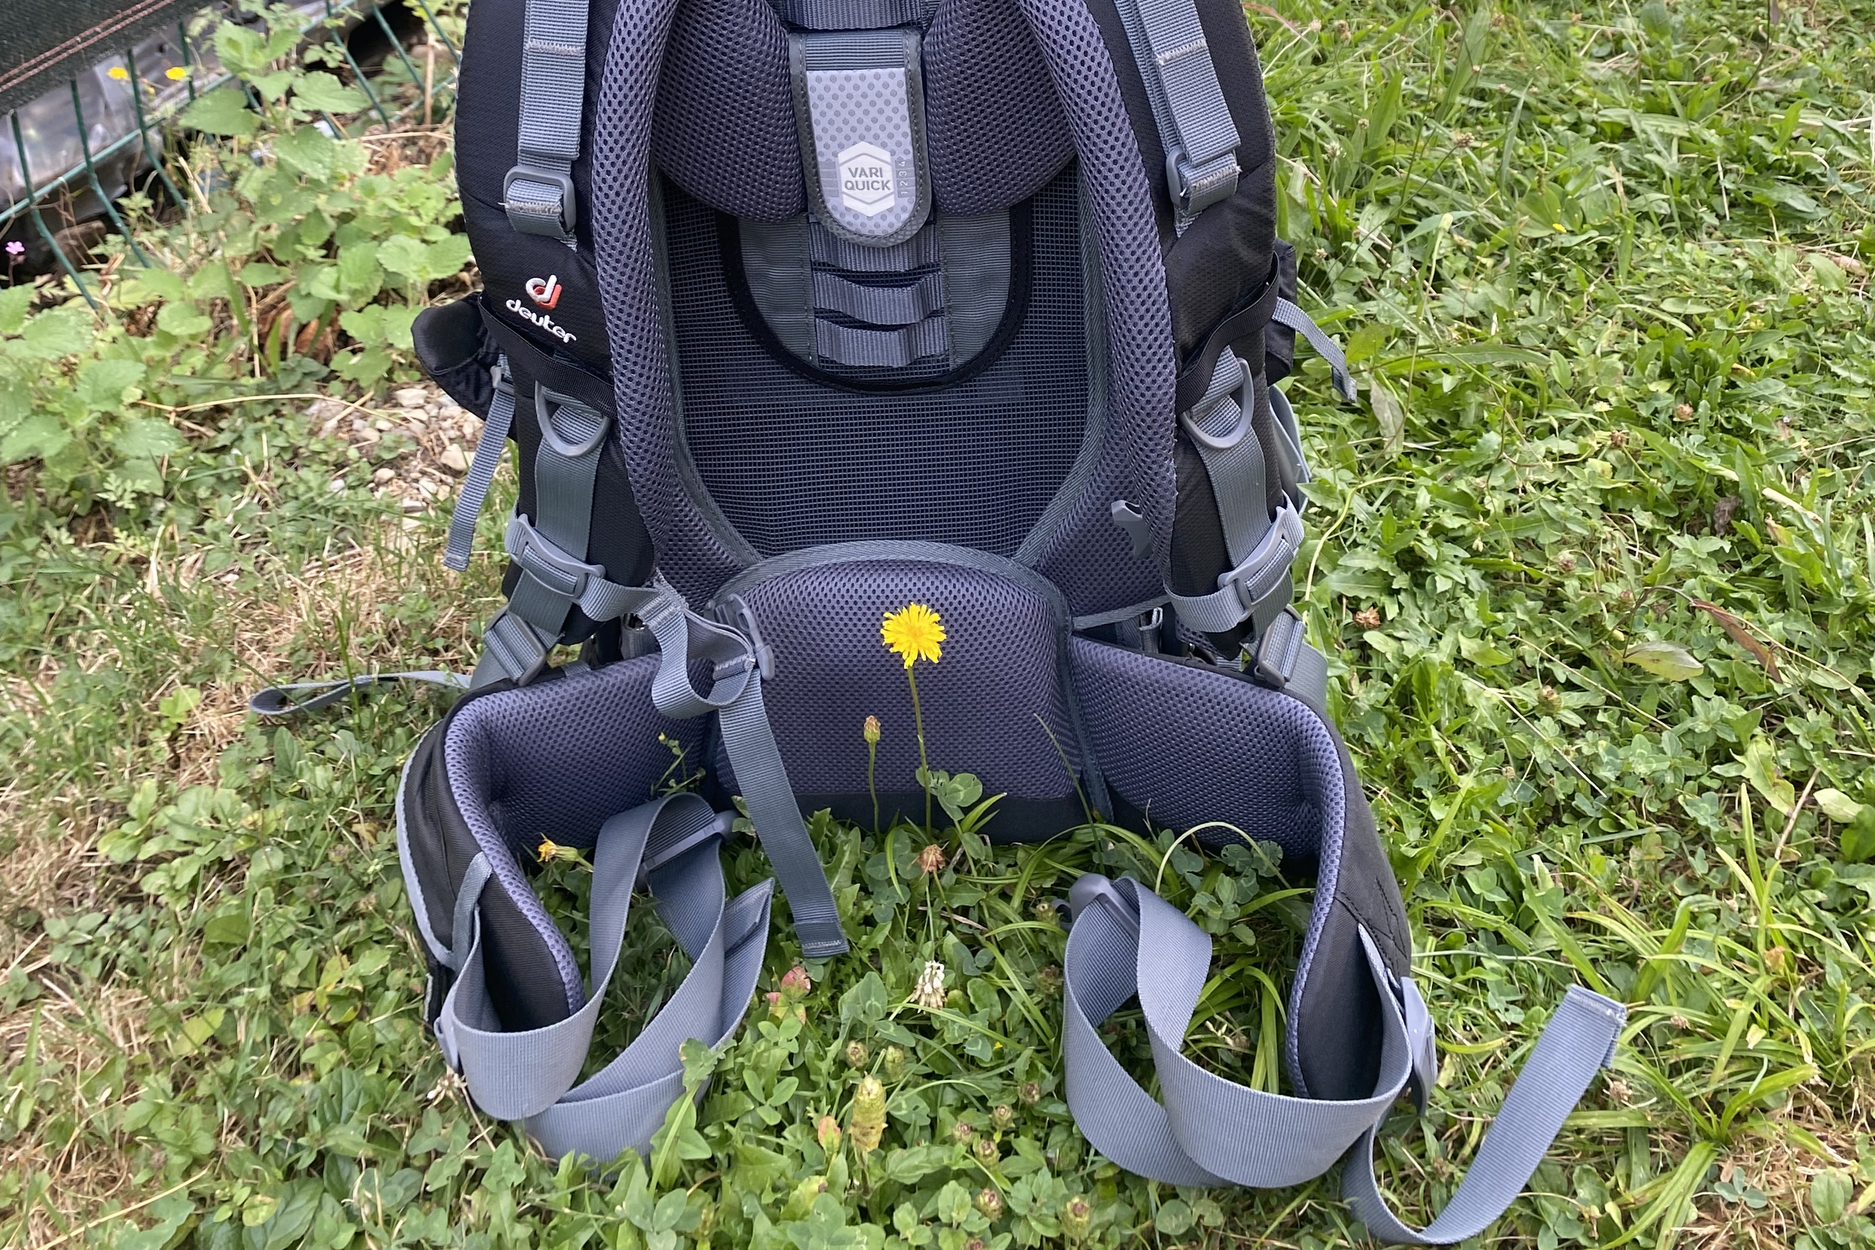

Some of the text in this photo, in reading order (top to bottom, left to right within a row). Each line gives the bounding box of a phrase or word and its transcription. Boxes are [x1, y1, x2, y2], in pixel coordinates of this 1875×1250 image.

[848, 167, 883, 178] VARI
[845, 181, 890, 190] QUICK
[506, 300, 576, 343] deuter
